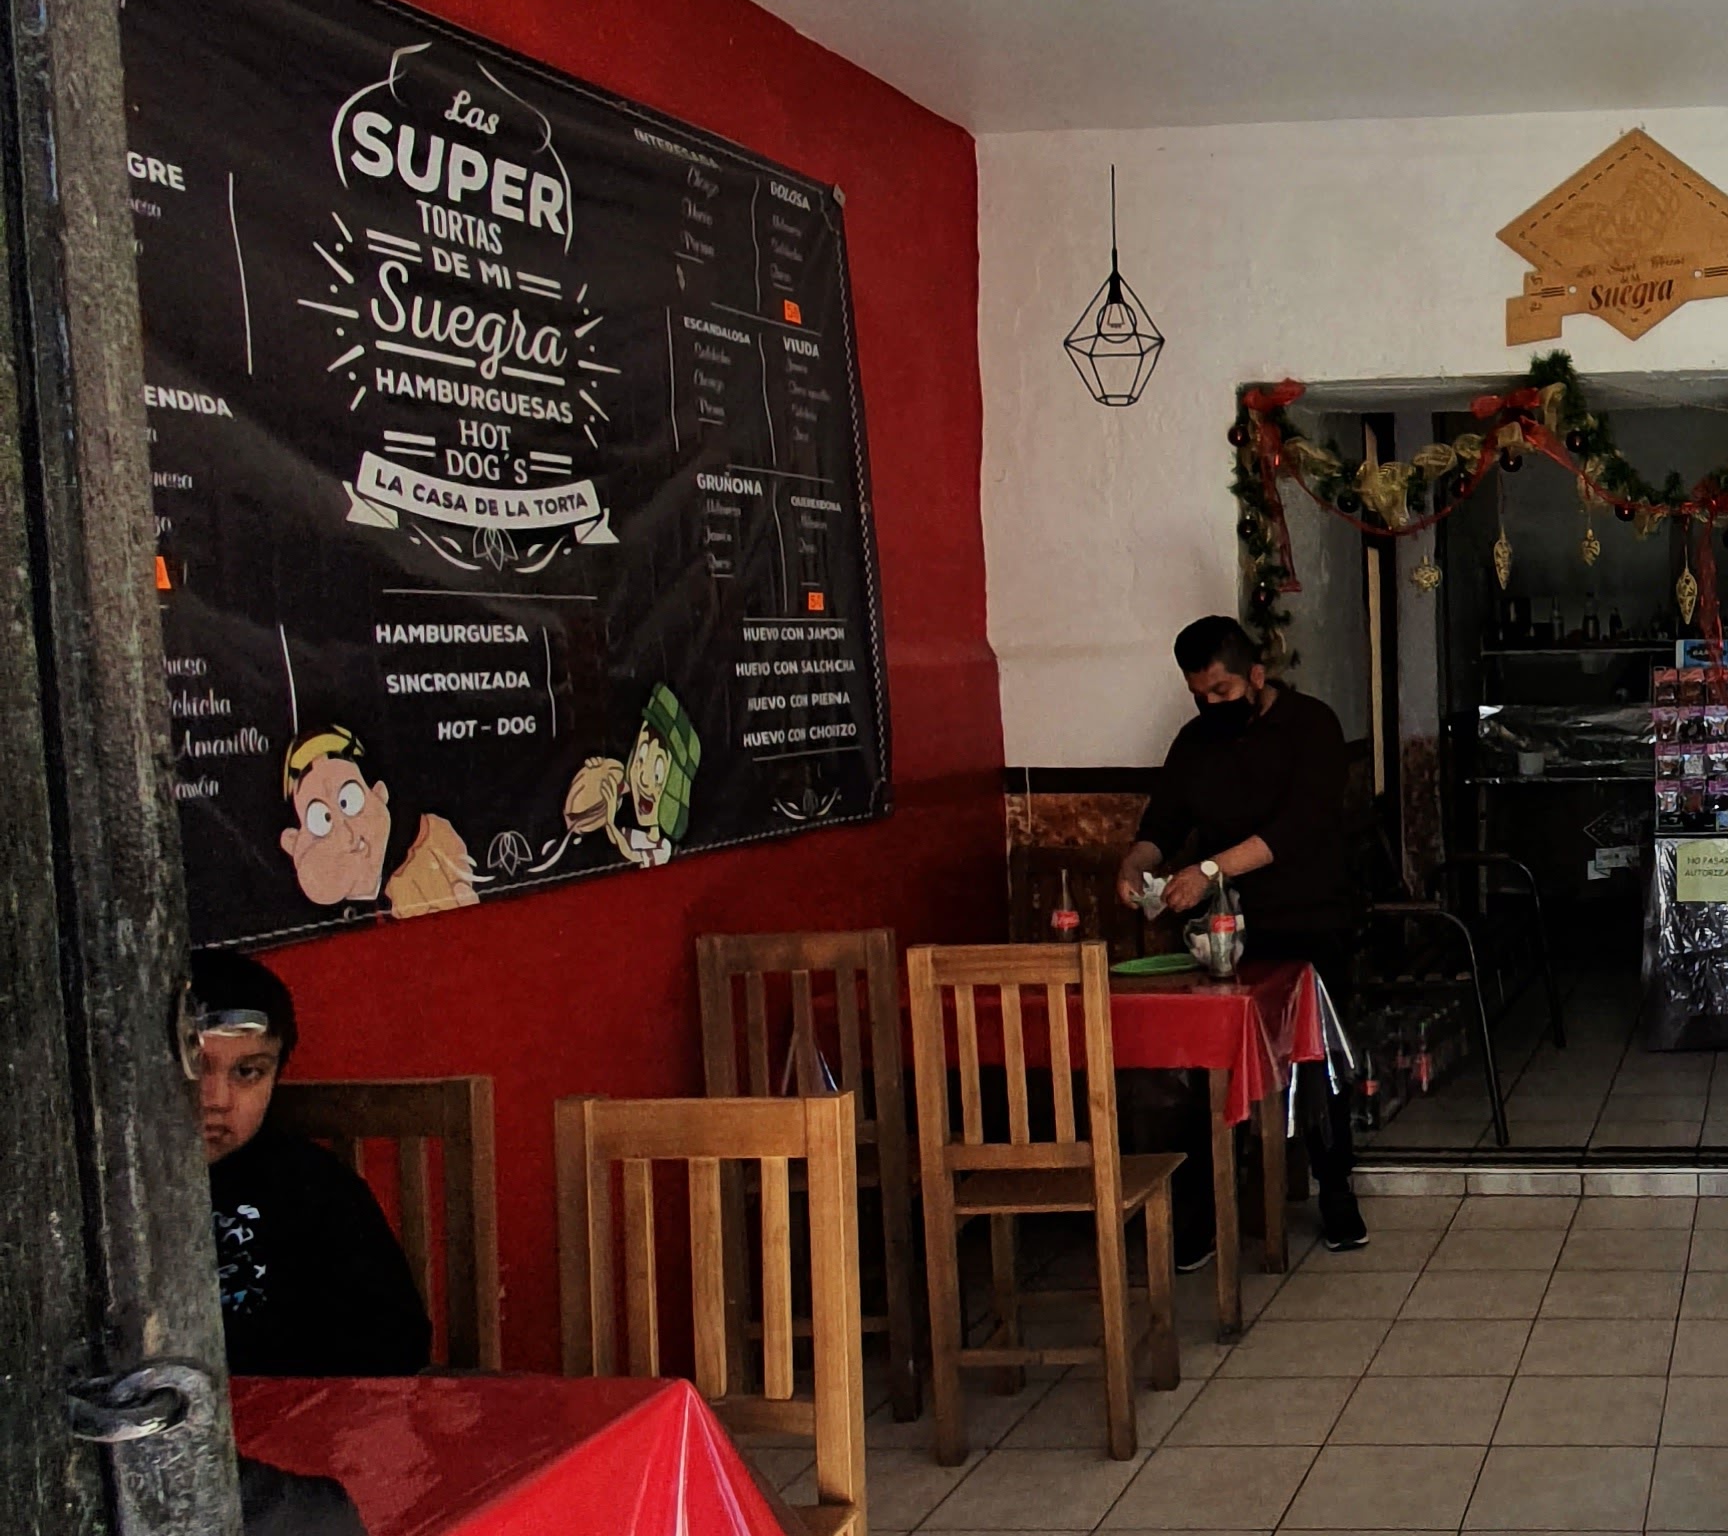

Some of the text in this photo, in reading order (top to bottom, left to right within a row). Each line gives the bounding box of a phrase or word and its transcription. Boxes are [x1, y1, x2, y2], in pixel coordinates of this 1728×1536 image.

[444, 89, 500, 135] Las
[351, 110, 565, 235] SUPER
[770, 180, 812, 212] GOLOSA
[416, 199, 503, 255] TORTAS
[432, 246, 512, 290] DE MI
[1588, 279, 1674, 312] Suegra
[371, 260, 568, 380] Suegra
[683, 316, 751, 346] ESCANDALOSA
[782, 336, 820, 359] VIUDA
[143, 384, 232, 418] ENDIDA
[375, 367, 574, 424] HAMBURGUESAS
[459, 418, 512, 452] HOT
[374, 468, 588, 517] LA CASA DE LA TORTA
[696, 471, 763, 496] GRUÑONA
[375, 623, 529, 645] HAMBURGUESA
[743, 627, 779, 641] HUEVO
[781, 627, 804, 641] CON
[386, 670, 531, 695] SINCRONIZADA
[774, 661, 799, 675] CON
[790, 693, 809, 708] CON
[437, 720, 478, 741] HOT
[497, 715, 536, 736] DOG
[743, 729, 785, 748] HUEVO
[787, 728, 806, 742] CON
[1687, 856, 1701, 865] NO
